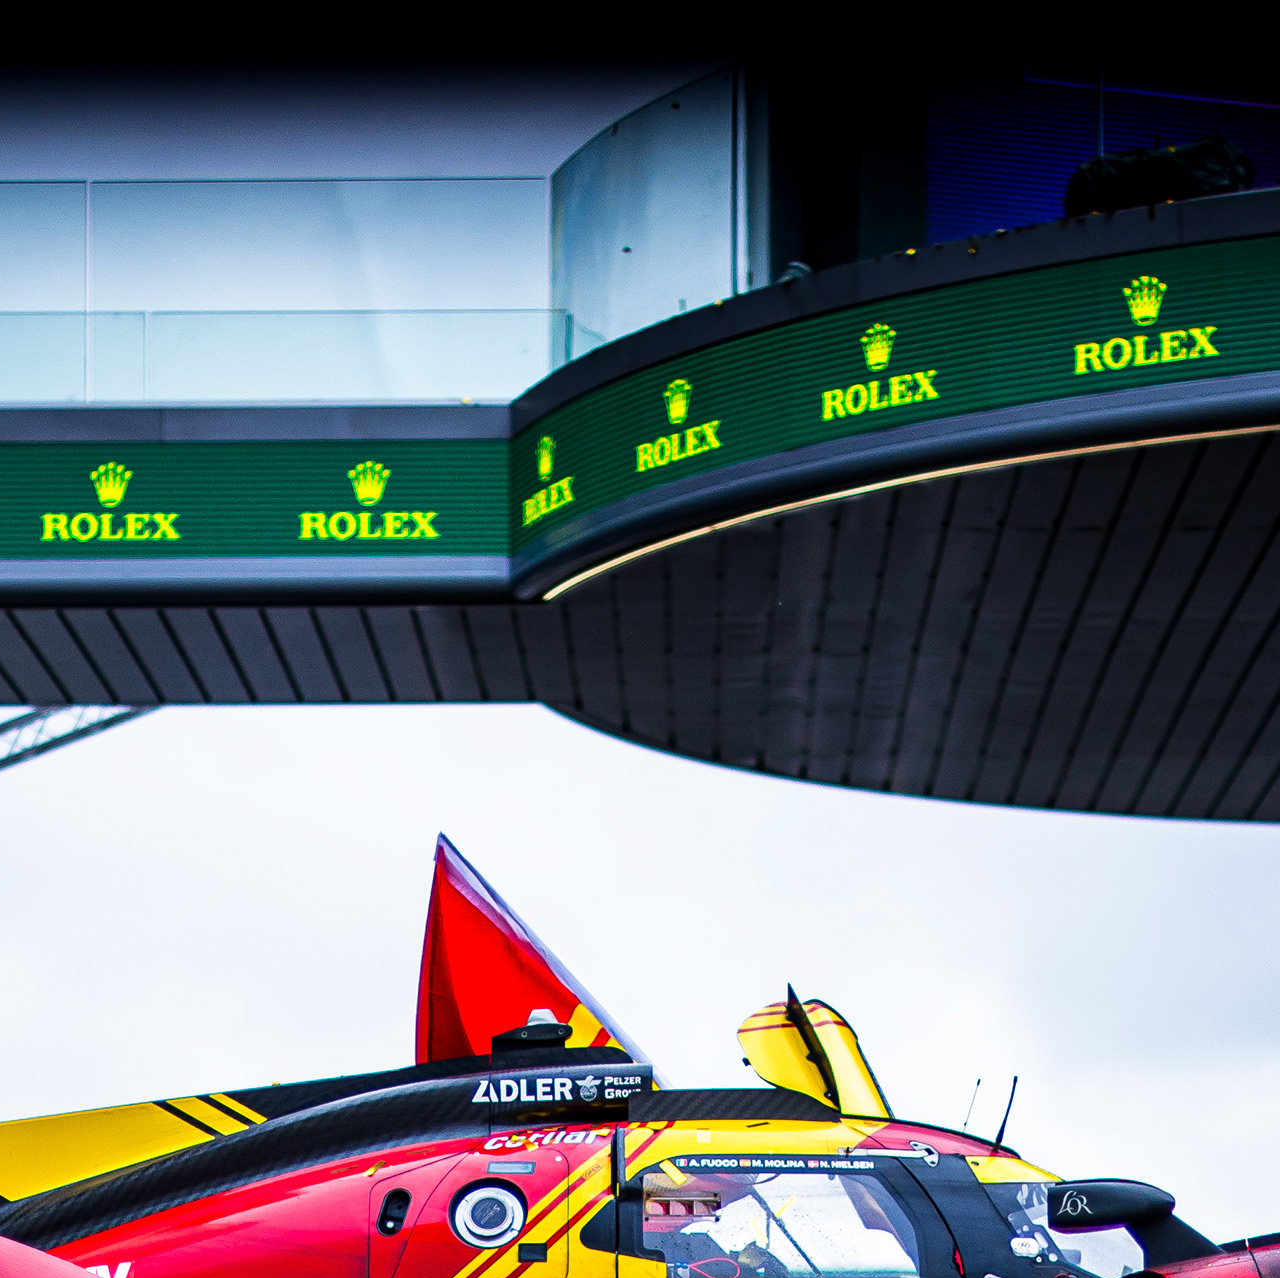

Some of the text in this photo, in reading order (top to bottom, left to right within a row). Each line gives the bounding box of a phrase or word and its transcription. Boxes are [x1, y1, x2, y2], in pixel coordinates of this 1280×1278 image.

[1074, 325, 1219, 375] ROLEX
[821, 369, 940, 422] ROLEX
[635, 419, 722, 473] ROLEX
[41, 512, 180, 542] ROLEX
[299, 511, 439, 540] ROLEX
[472, 1077, 573, 1103] ADLER
[688, 1159, 875, 1170] A. FUOCO M. MOLINA N. NIELSEN
